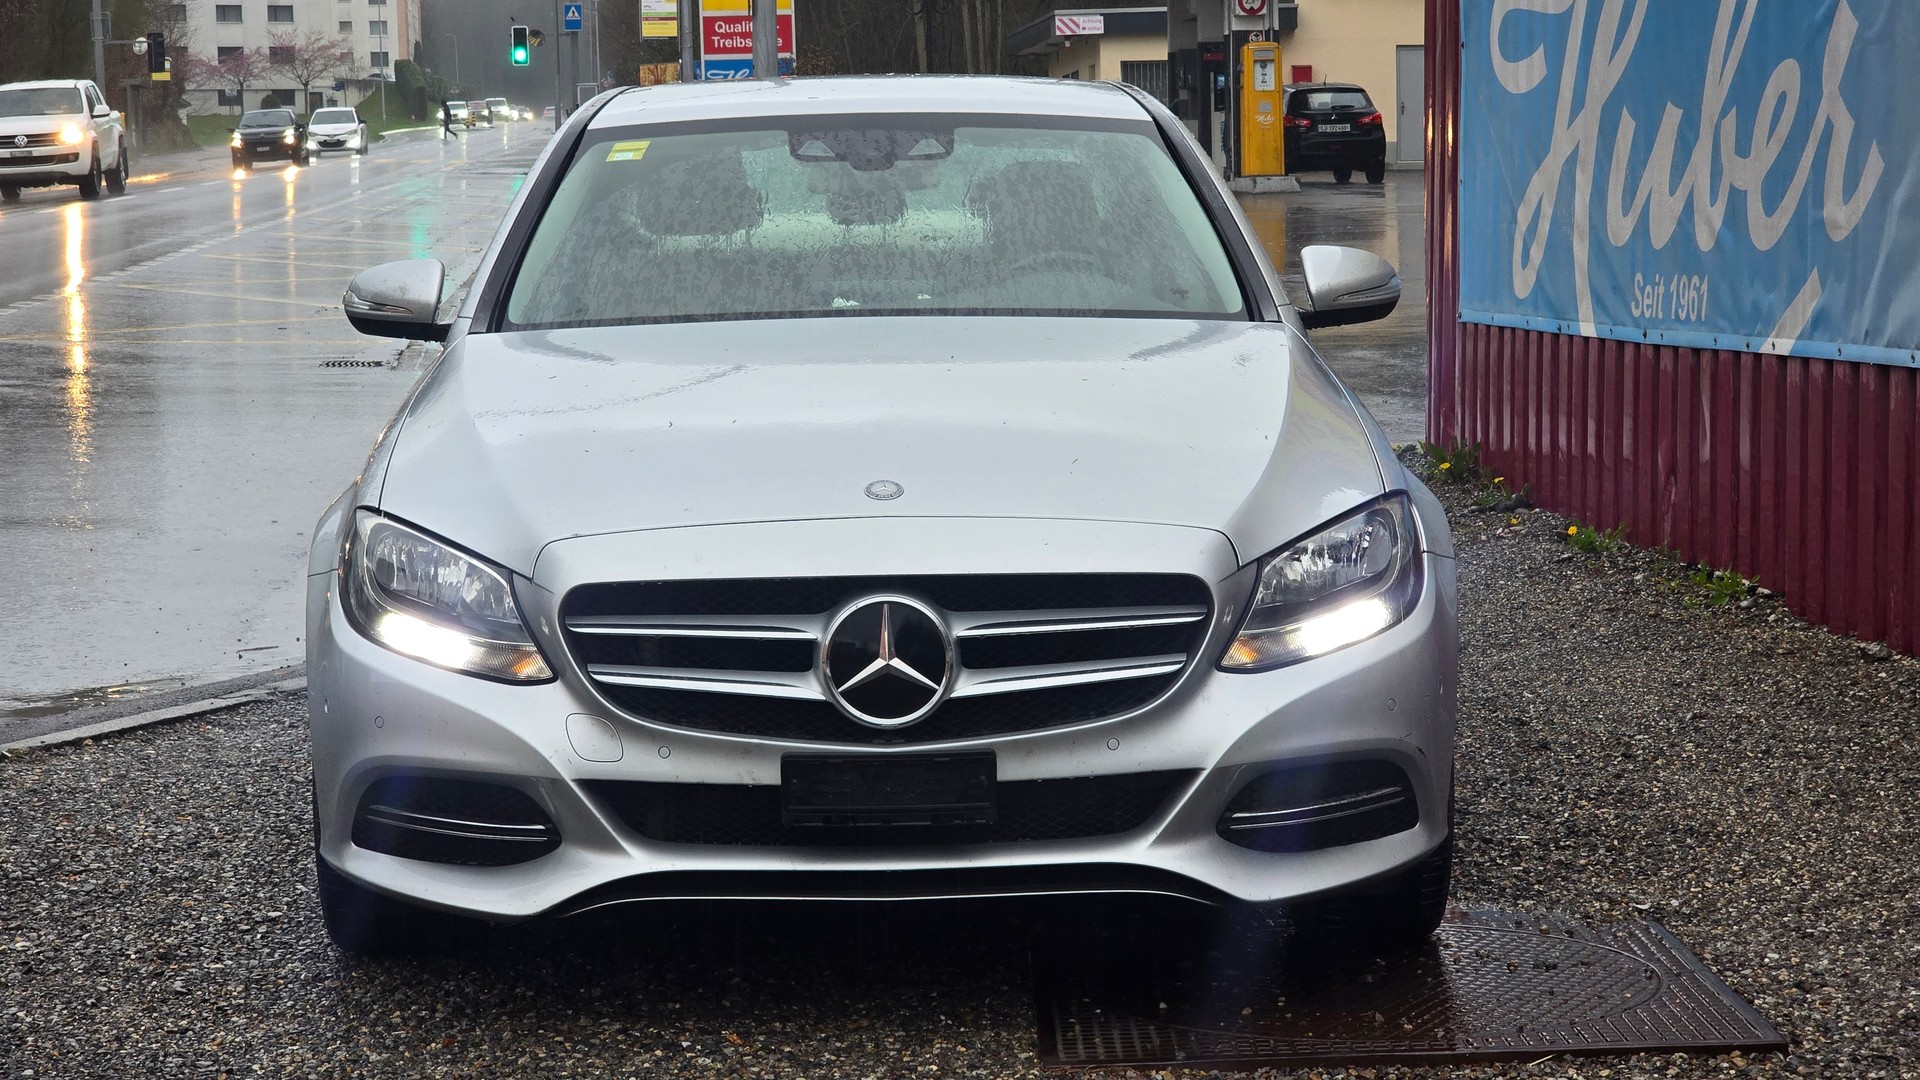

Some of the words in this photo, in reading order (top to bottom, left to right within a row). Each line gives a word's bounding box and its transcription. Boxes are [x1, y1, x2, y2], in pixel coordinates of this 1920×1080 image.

[711, 36, 783, 48] Treibse
[1490, 0, 1885, 312] Huber
[1631, 272, 1665, 319] Seit
[1670, 273, 1708, 321] 1961
